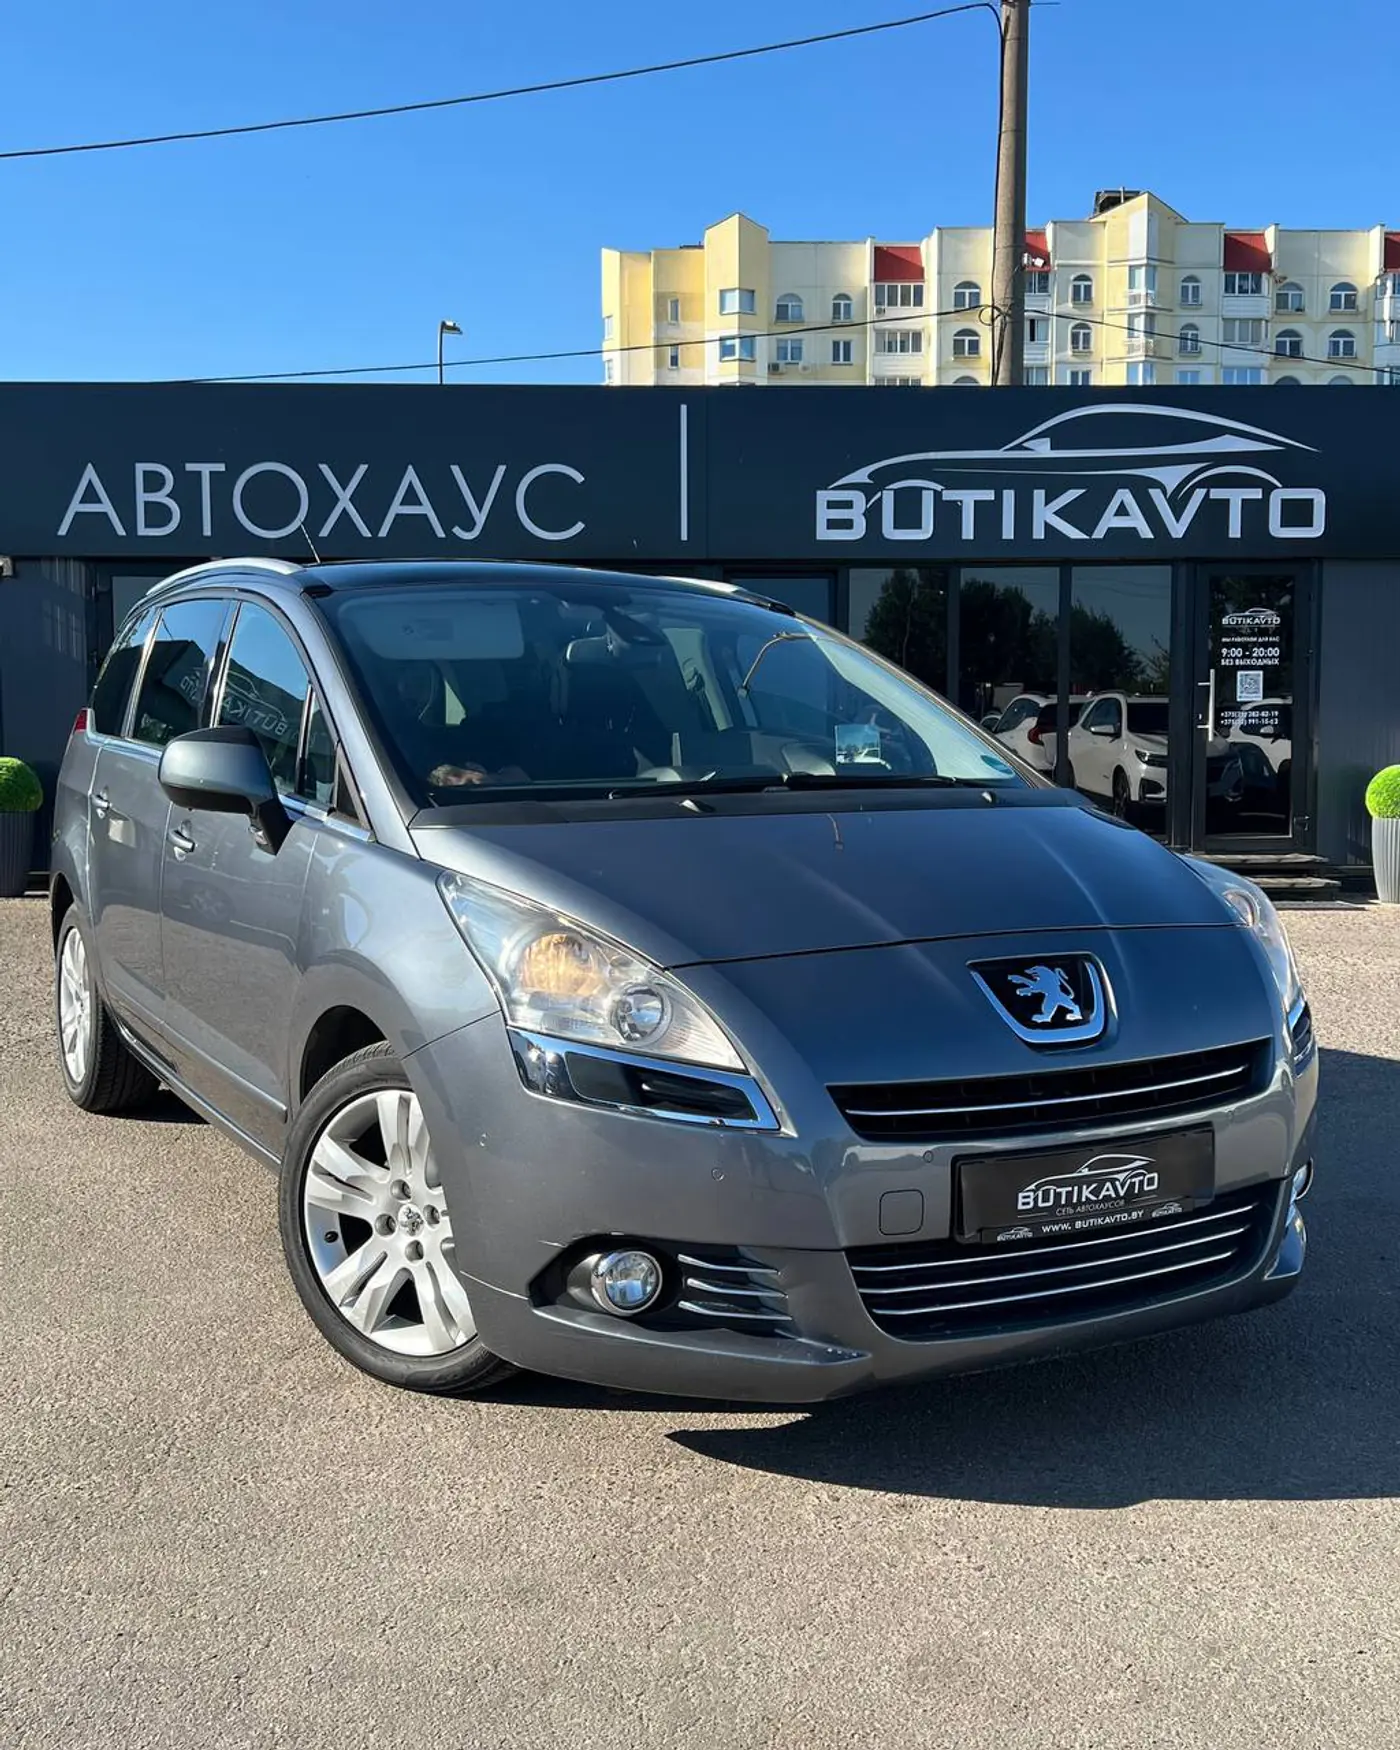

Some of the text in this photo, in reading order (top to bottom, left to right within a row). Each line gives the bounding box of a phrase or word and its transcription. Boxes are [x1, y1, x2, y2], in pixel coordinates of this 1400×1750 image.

[57, 461, 586, 540] АВТОХАУС
[816, 487, 1326, 541] BUTIKAVTO
[1222, 616, 1280, 625] BUTIKAVTO
[1221, 648, 1243, 657] 9:00
[1252, 647, 1280, 657] 20:00
[1235, 658, 1280, 666] ВЫХОДНЫХ
[1017, 1172, 1159, 1210] BUTIKAVTO
[1056, 1206, 1075, 1216] СЕТЬ
[1075, 1210, 1145, 1229] BUTIKAVTO.BY
